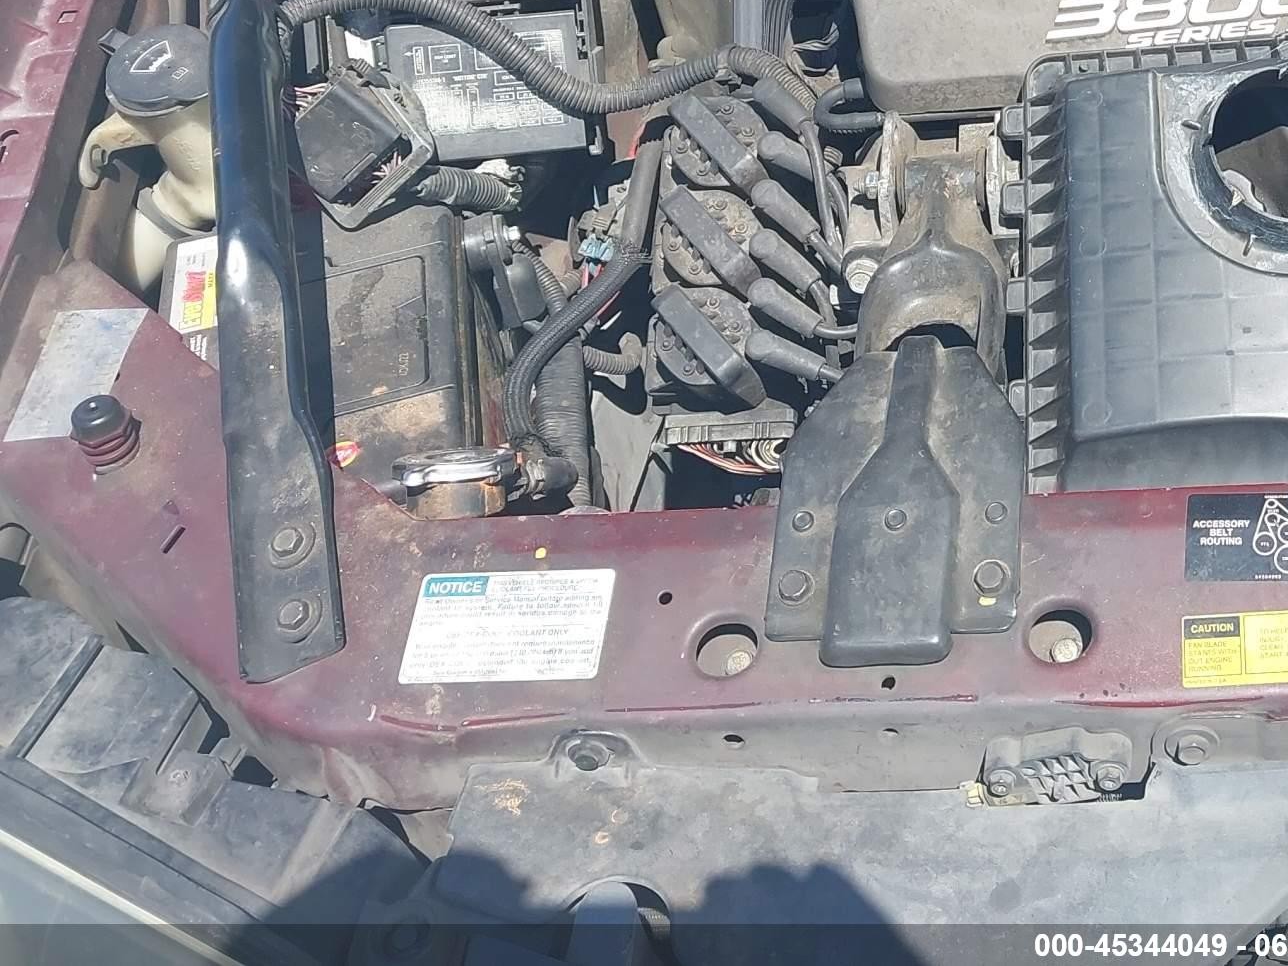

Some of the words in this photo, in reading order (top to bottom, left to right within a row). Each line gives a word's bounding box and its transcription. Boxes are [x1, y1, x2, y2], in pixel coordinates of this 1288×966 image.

[1126, 17, 1277, 48] SERIES
[1192, 519, 1250, 529] ACCESSORY
[1209, 528, 1233, 537] BELT
[1200, 537, 1243, 546] ROUTING
[429, 581, 483, 594] NOTICE
[1190, 622, 1234, 634] CAUTION
